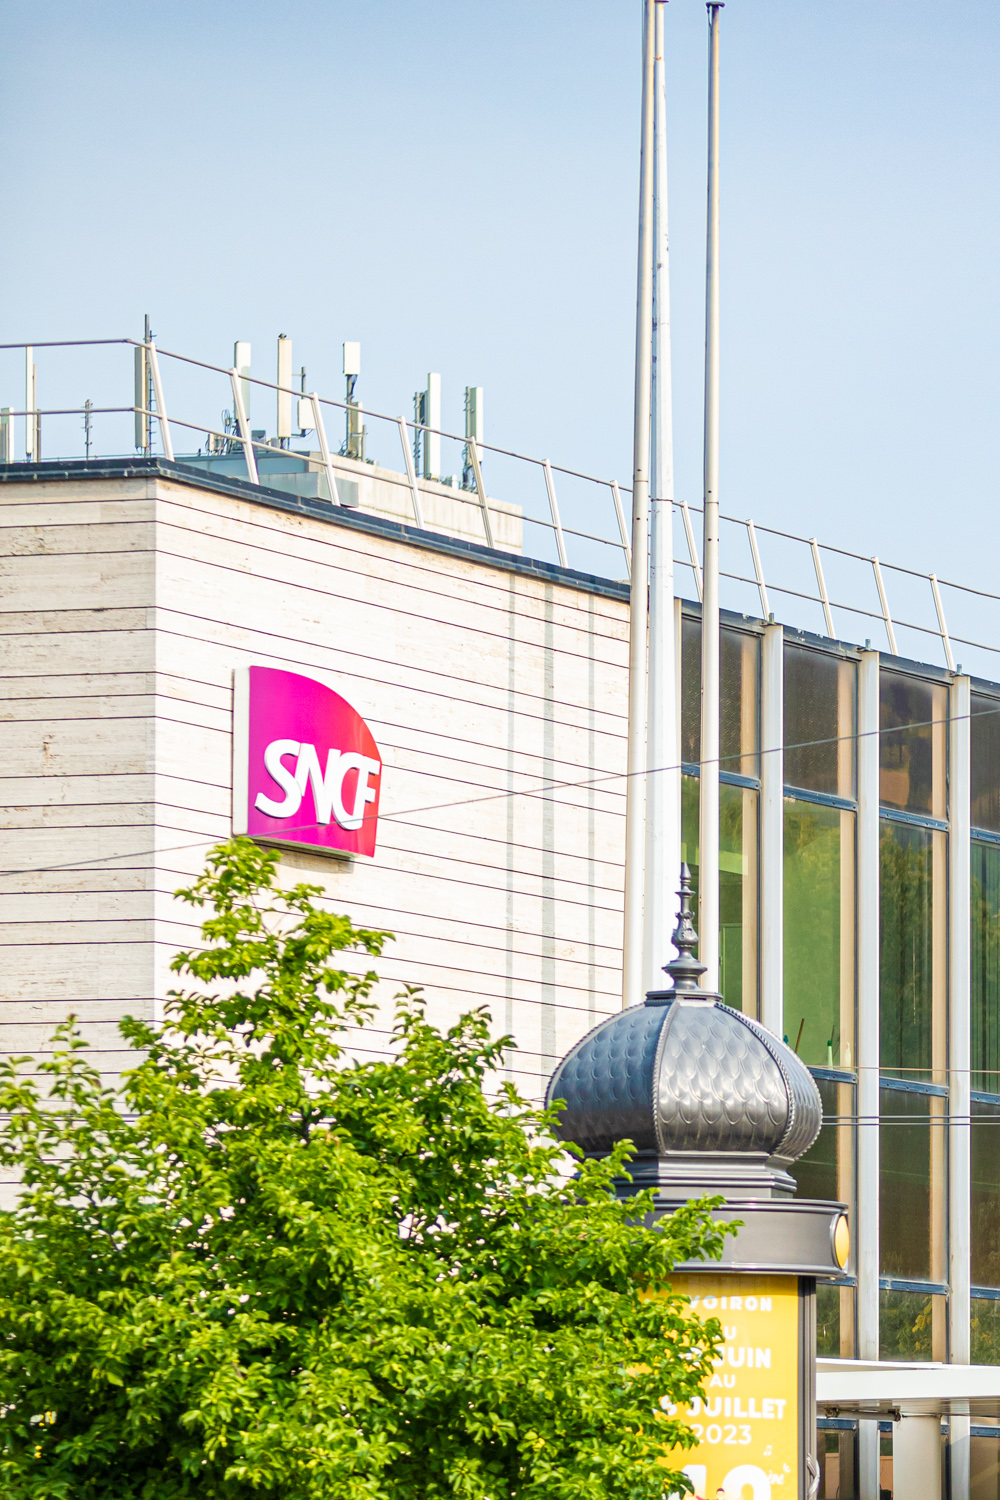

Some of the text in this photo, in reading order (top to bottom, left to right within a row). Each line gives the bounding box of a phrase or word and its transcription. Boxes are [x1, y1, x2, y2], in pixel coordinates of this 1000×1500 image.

[254, 739, 381, 831] SNCF
[688, 1295, 772, 1311] VOIRON
[711, 1346, 771, 1368] JUIN
[709, 1373, 736, 1388] AU
[685, 1396, 787, 1419] JUILLET
[690, 1423, 752, 1445] 2023
